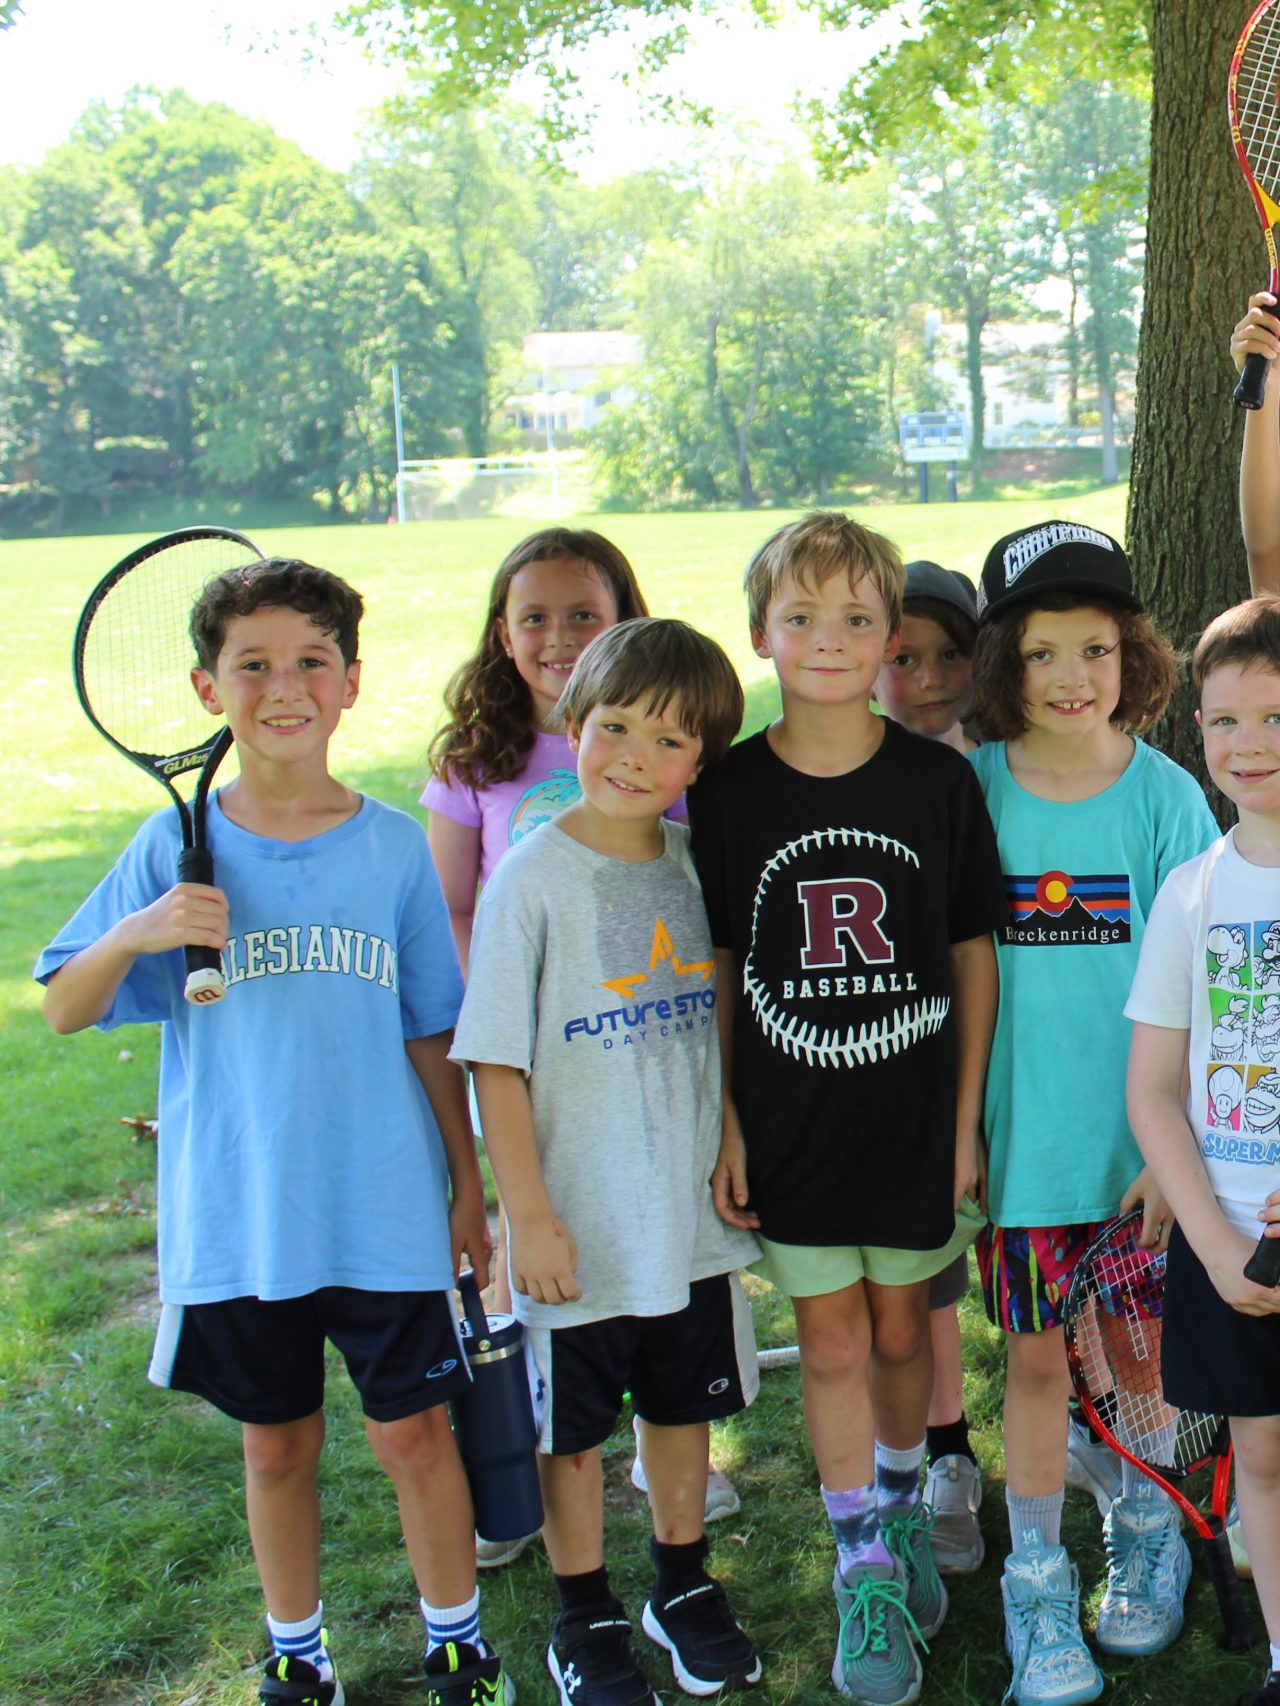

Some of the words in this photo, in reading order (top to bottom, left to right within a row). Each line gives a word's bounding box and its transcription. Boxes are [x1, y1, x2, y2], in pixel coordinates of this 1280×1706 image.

[797, 877, 895, 970] R
[1005, 926, 1121, 944] Breckenridge
[783, 972, 917, 999] BASEBALL
[603, 1031, 647, 1050] DAY
[660, 1015, 709, 1037] CAMP
[1203, 1131, 1265, 1165] SUPER
